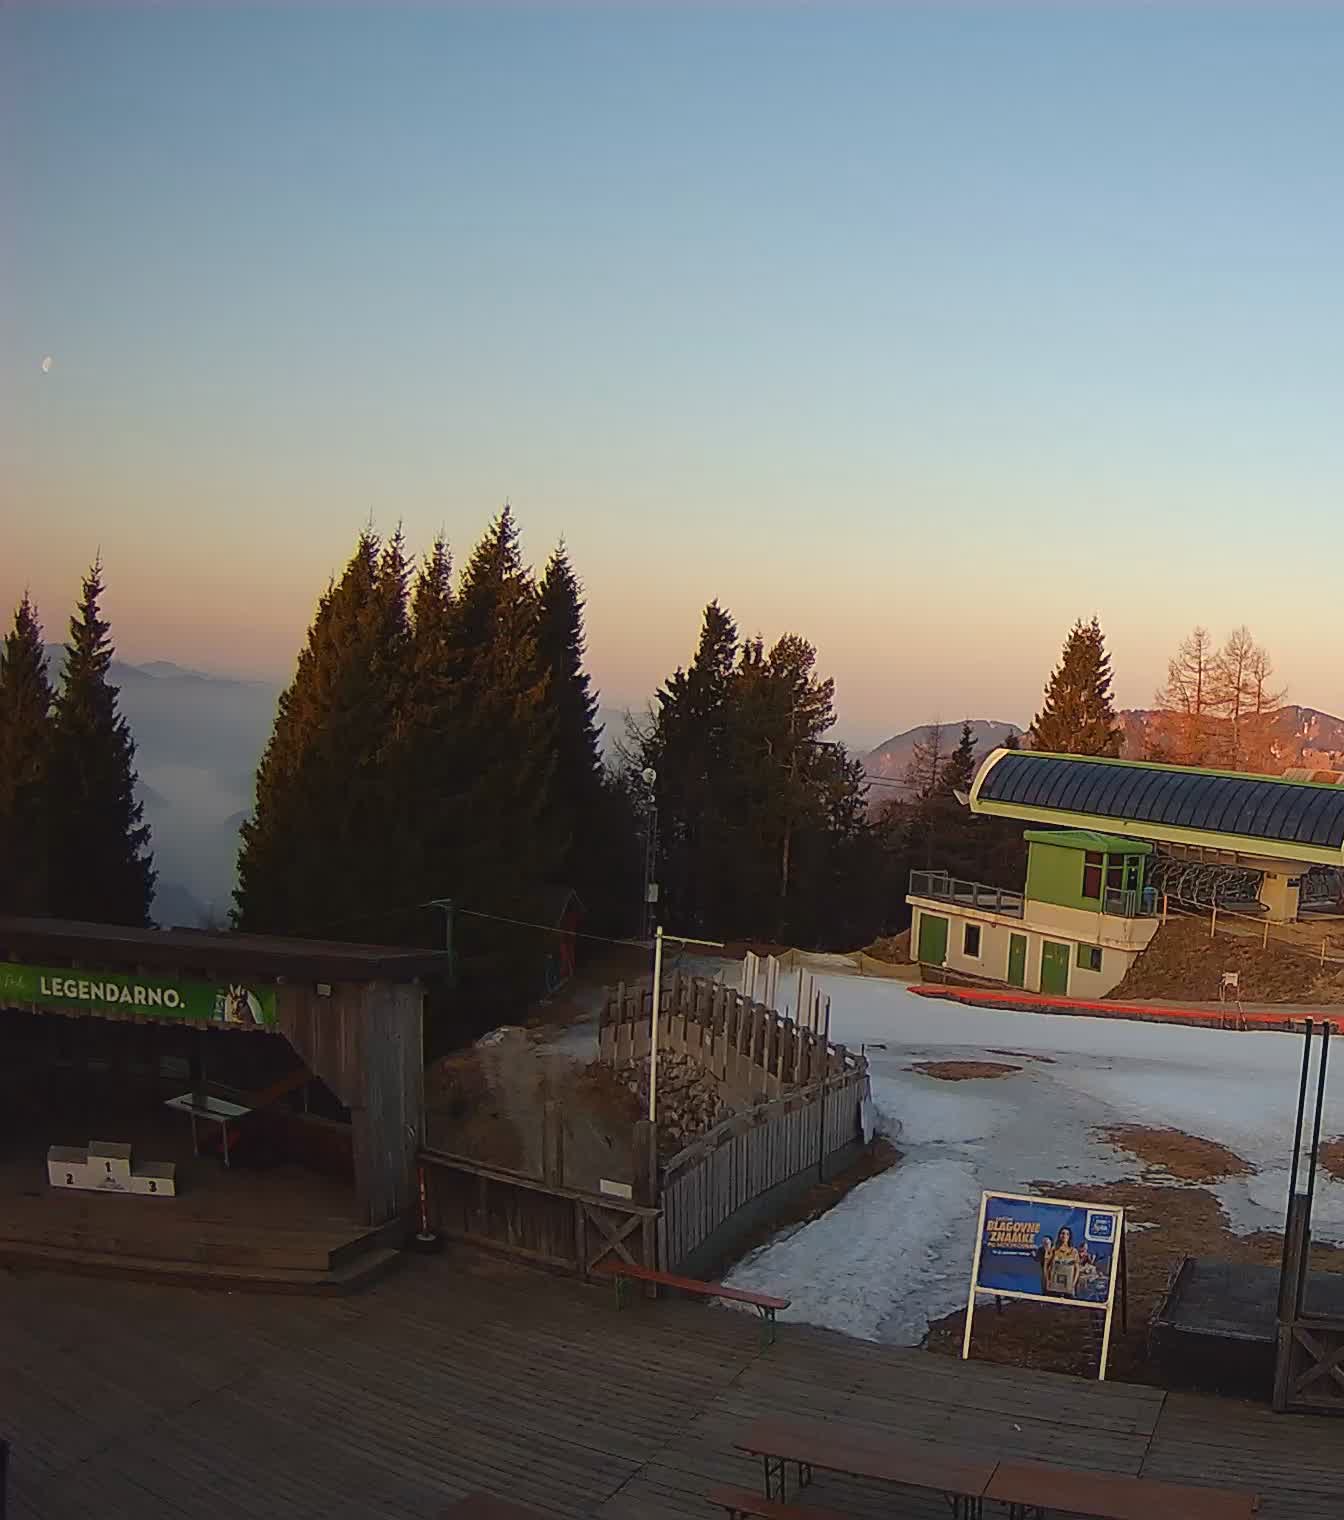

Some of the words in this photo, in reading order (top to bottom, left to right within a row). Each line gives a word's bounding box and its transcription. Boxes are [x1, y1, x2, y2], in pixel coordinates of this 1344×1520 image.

[40, 976, 186, 1009] LEGENDARNO.
[105, 1161, 112, 1173] 1
[66, 1173, 74, 1185] 2
[148, 1180, 157, 1193] 3
[989, 1231, 1036, 1244] ZNAMKE
